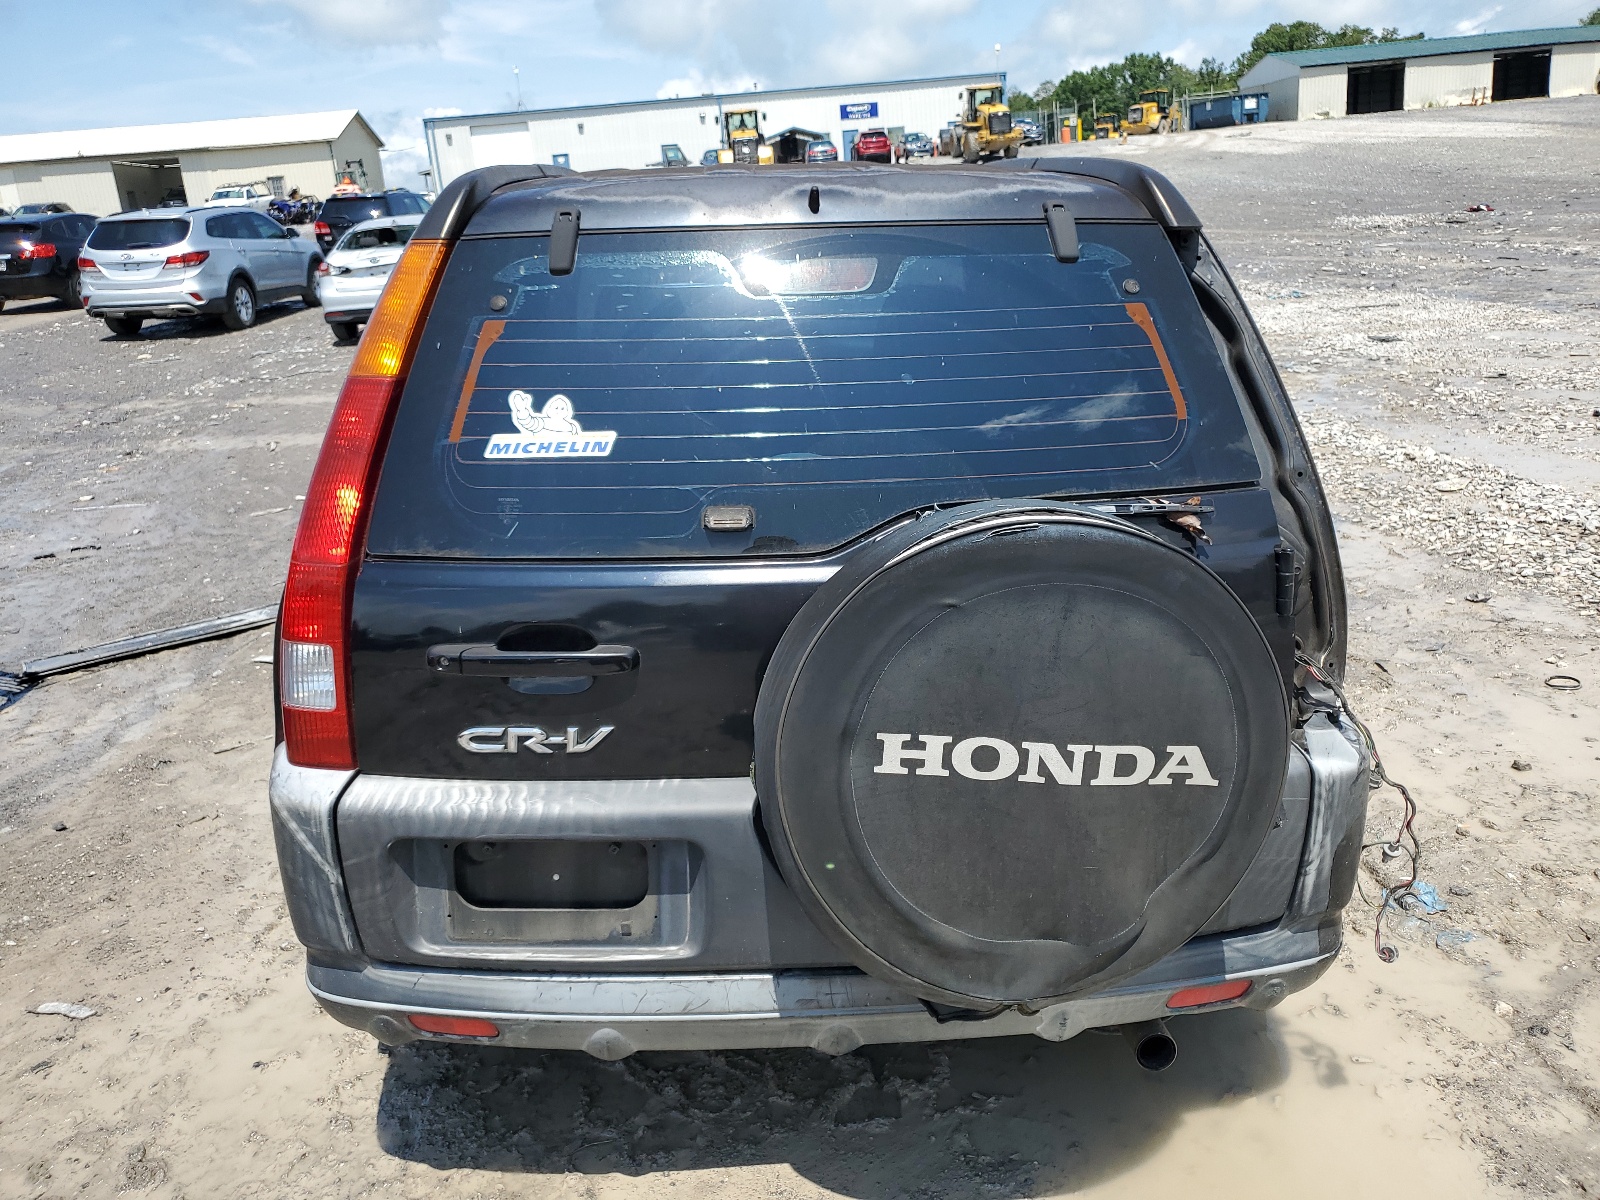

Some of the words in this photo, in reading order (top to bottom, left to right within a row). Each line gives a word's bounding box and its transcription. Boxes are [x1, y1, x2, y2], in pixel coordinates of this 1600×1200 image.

[489, 441, 609, 455] MICHELIN
[457, 725, 615, 754] CR-V
[873, 732, 1220, 787] HONDA
